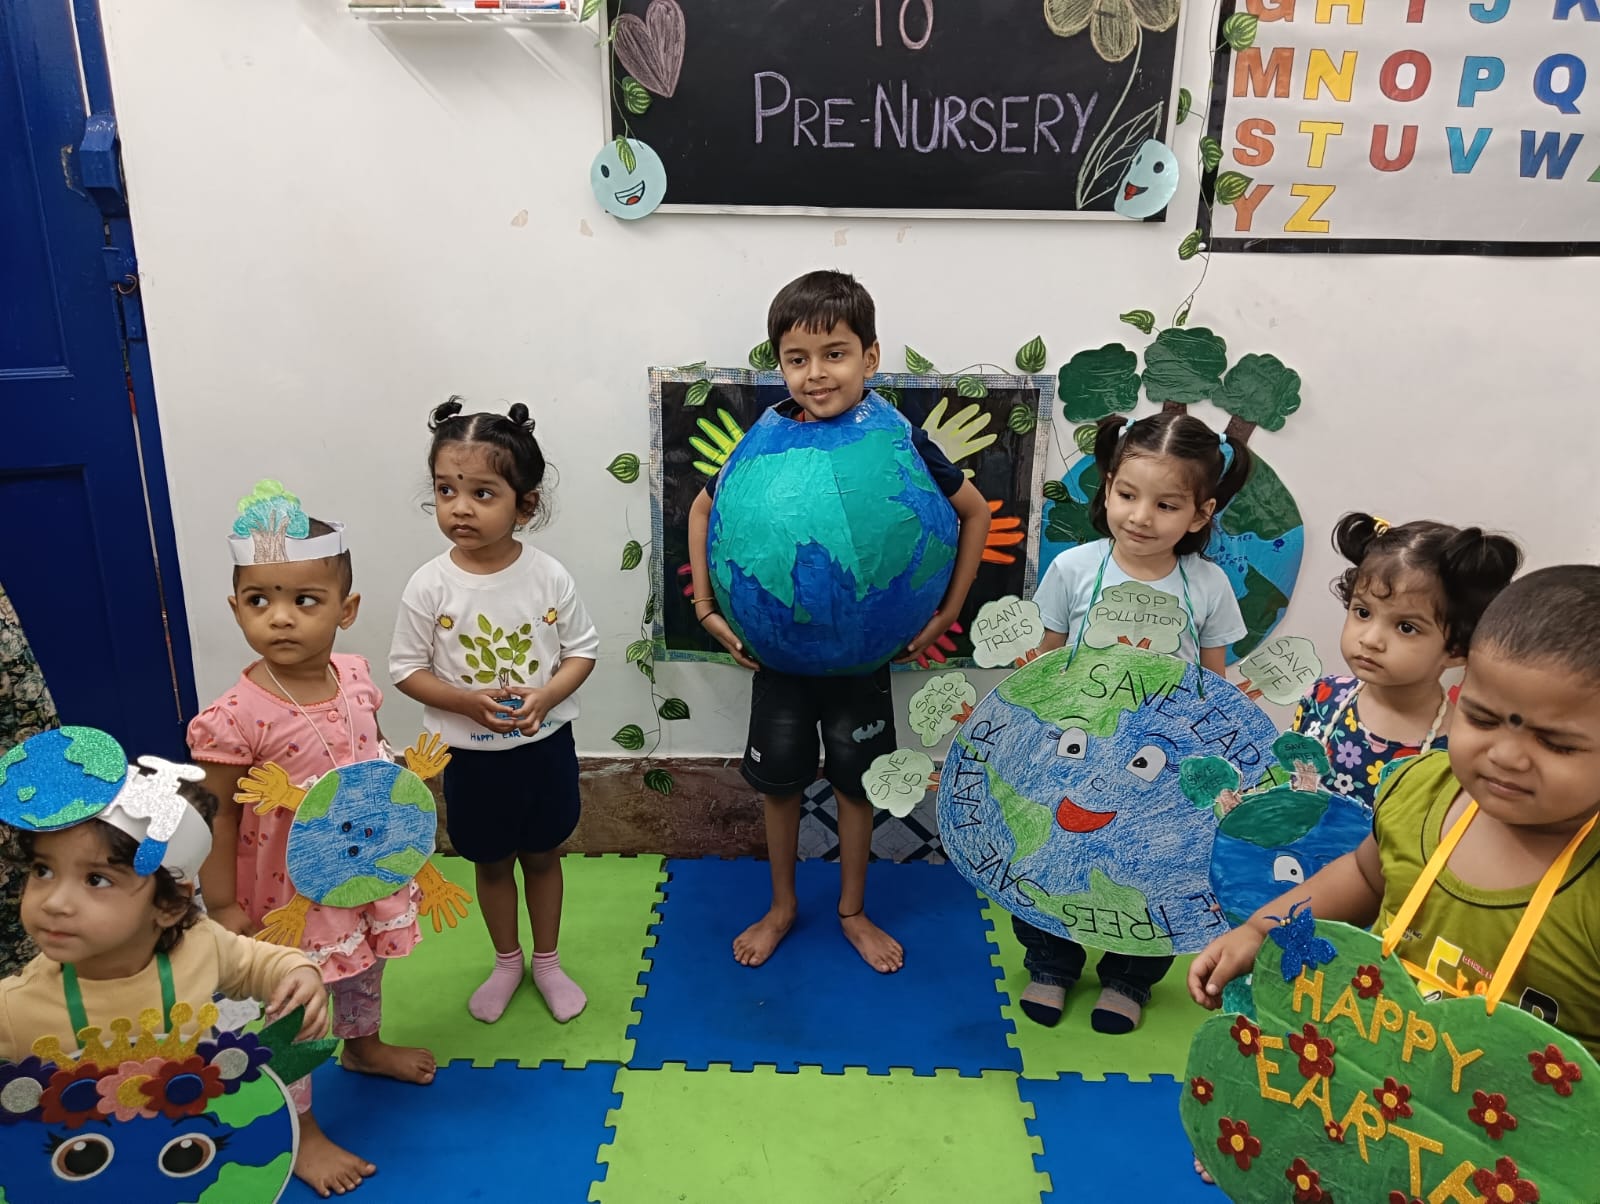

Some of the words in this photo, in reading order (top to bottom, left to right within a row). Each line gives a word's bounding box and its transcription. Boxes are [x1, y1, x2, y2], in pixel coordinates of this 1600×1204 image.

[1233, 47, 1295, 98] M
[1303, 48, 1358, 102] N
[1379, 49, 1431, 102] O
[1457, 56, 1505, 107] P
[1533, 53, 1587, 114] Q
[1232, 118, 1276, 167] S
[1298, 121, 1344, 168] T
[1369, 124, 1418, 172] U
[1445, 127, 1493, 174] V
[1520, 130, 1584, 179] W
[1233, 184, 1274, 232] Y
[1284, 183, 1336, 233] Z
[976, 600, 1025, 636] PLANT
[1095, 607, 1182, 627] POLLUTION
[1111, 590, 1167, 607] STOP
[979, 618, 1033, 652] TREES
[1249, 651, 1292, 690] LIFE
[1267, 639, 1315, 684] SAVE
[916, 684, 937, 712] SAY
[917, 705, 936, 728] NO
[929, 687, 966, 732] PLASTIC
[470, 732, 494, 742] HAPPY
[1080, 663, 1191, 718] SAVE
[1190, 706, 1277, 793] EART
[1284, 742, 1309, 751] SAVE
[871, 753, 907, 800] SAVE
[895, 772, 922, 795] US
[952, 720, 1007, 829] WATER
[967, 842, 1050, 907] SAVE
[1062, 904, 1185, 941] TREES
[1292, 964, 1484, 1093] HAPPY
